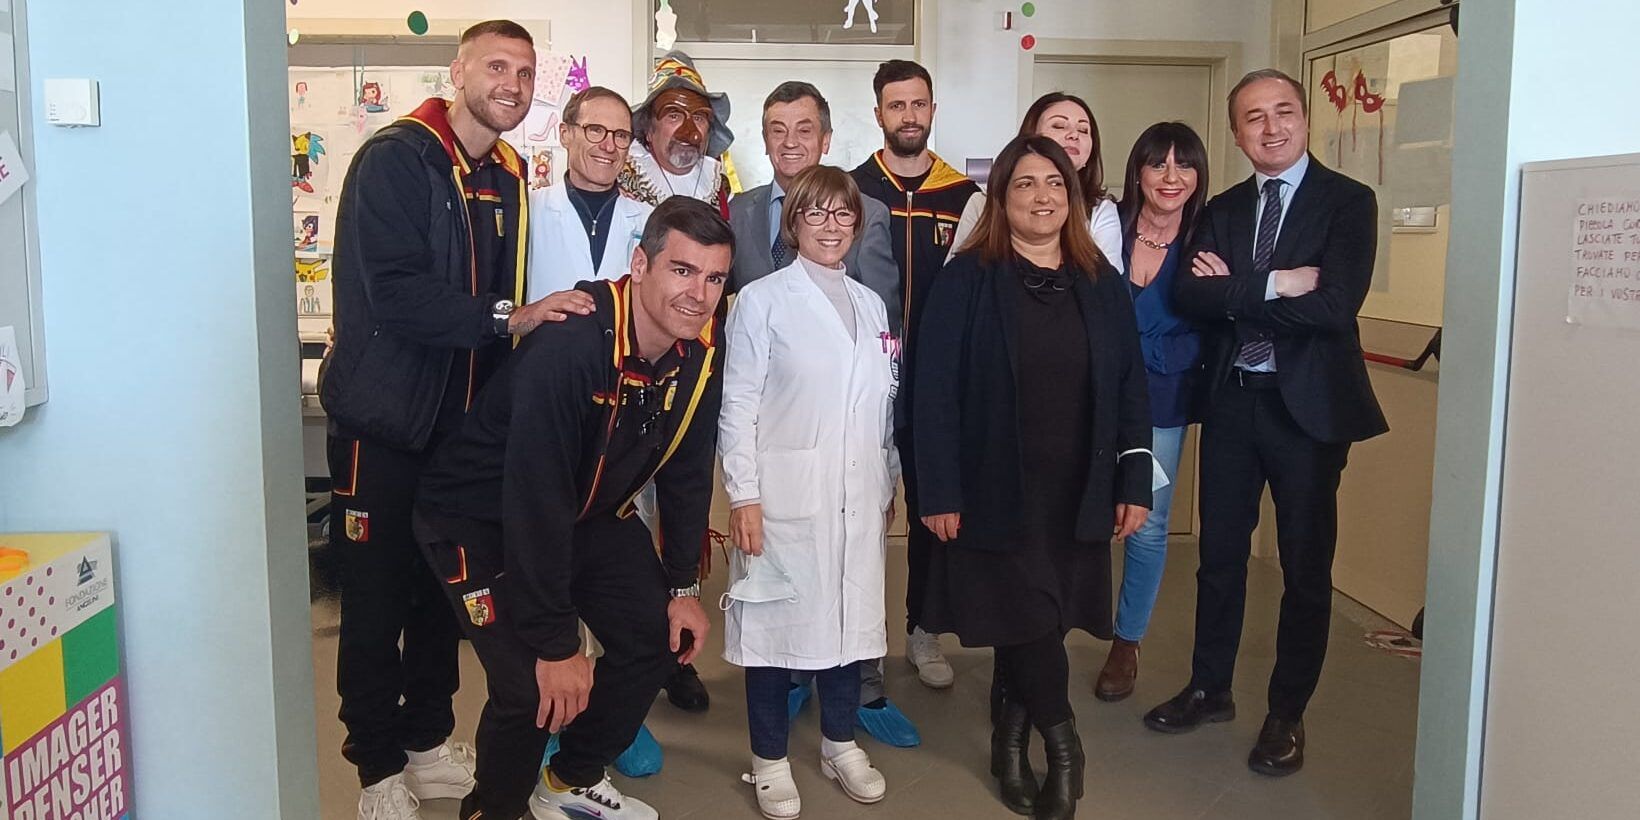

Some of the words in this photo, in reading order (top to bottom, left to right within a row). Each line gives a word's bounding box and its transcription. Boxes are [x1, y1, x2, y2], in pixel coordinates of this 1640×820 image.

[1577, 232, 1624, 245] LASCIATE
[1574, 249, 1614, 261] TROVATE
[1577, 266, 1630, 279] FACCIAMO
[1574, 284, 1593, 297] PER
[10, 686, 118, 804] IMAGER
[14, 728, 122, 820] PENSER
[70, 774, 124, 820] HER
